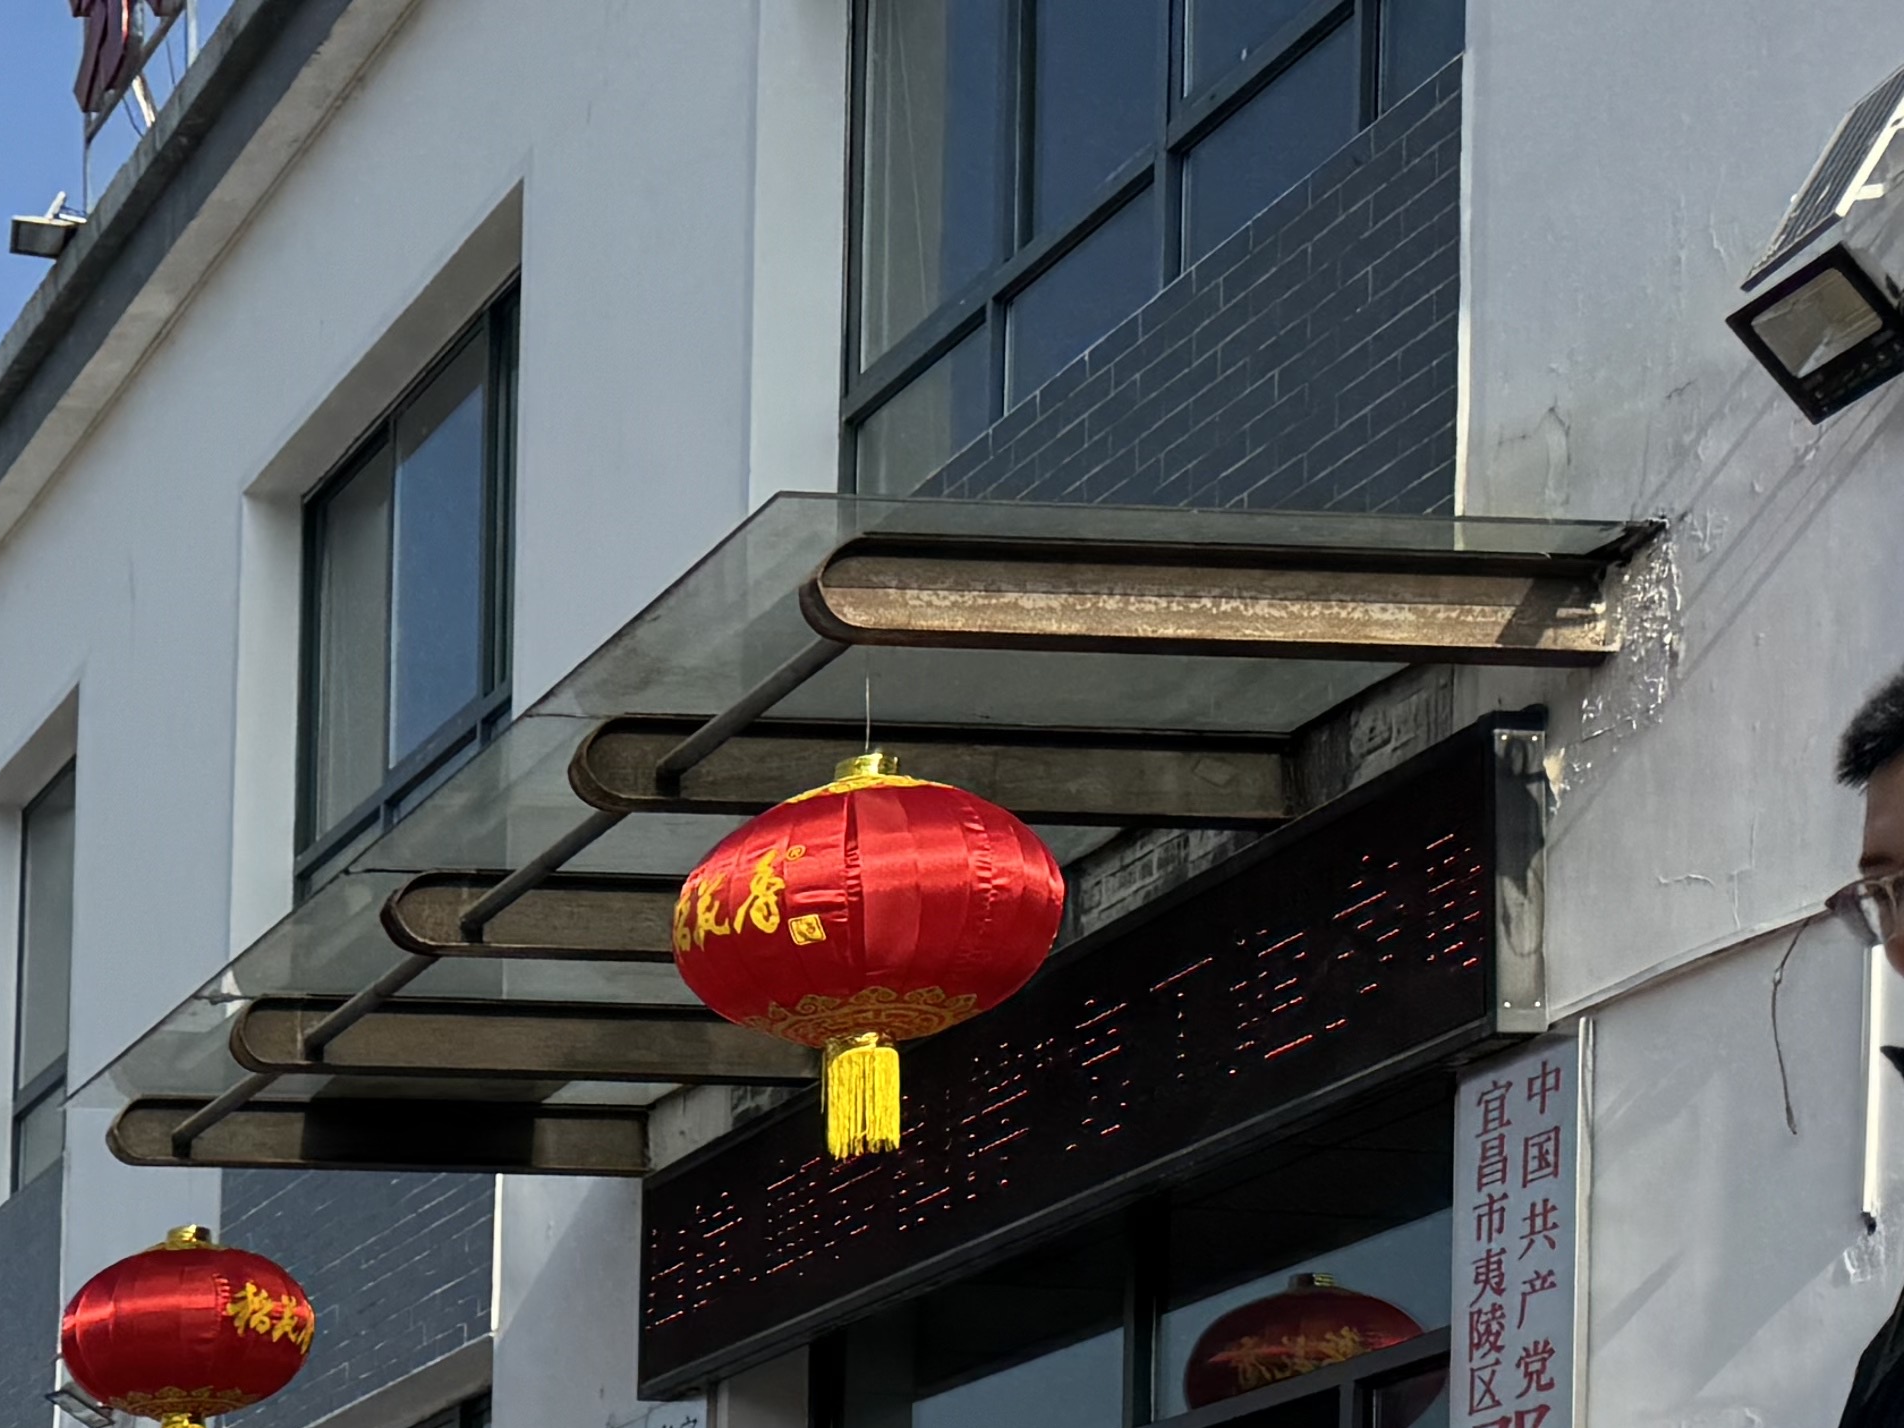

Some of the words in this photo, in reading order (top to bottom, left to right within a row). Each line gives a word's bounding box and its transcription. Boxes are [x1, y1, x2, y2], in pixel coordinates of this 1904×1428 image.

[1467, 1080, 1514, 1417] 宜昌市夷陵区
[1515, 1060, 1562, 1399] 中国共产党
